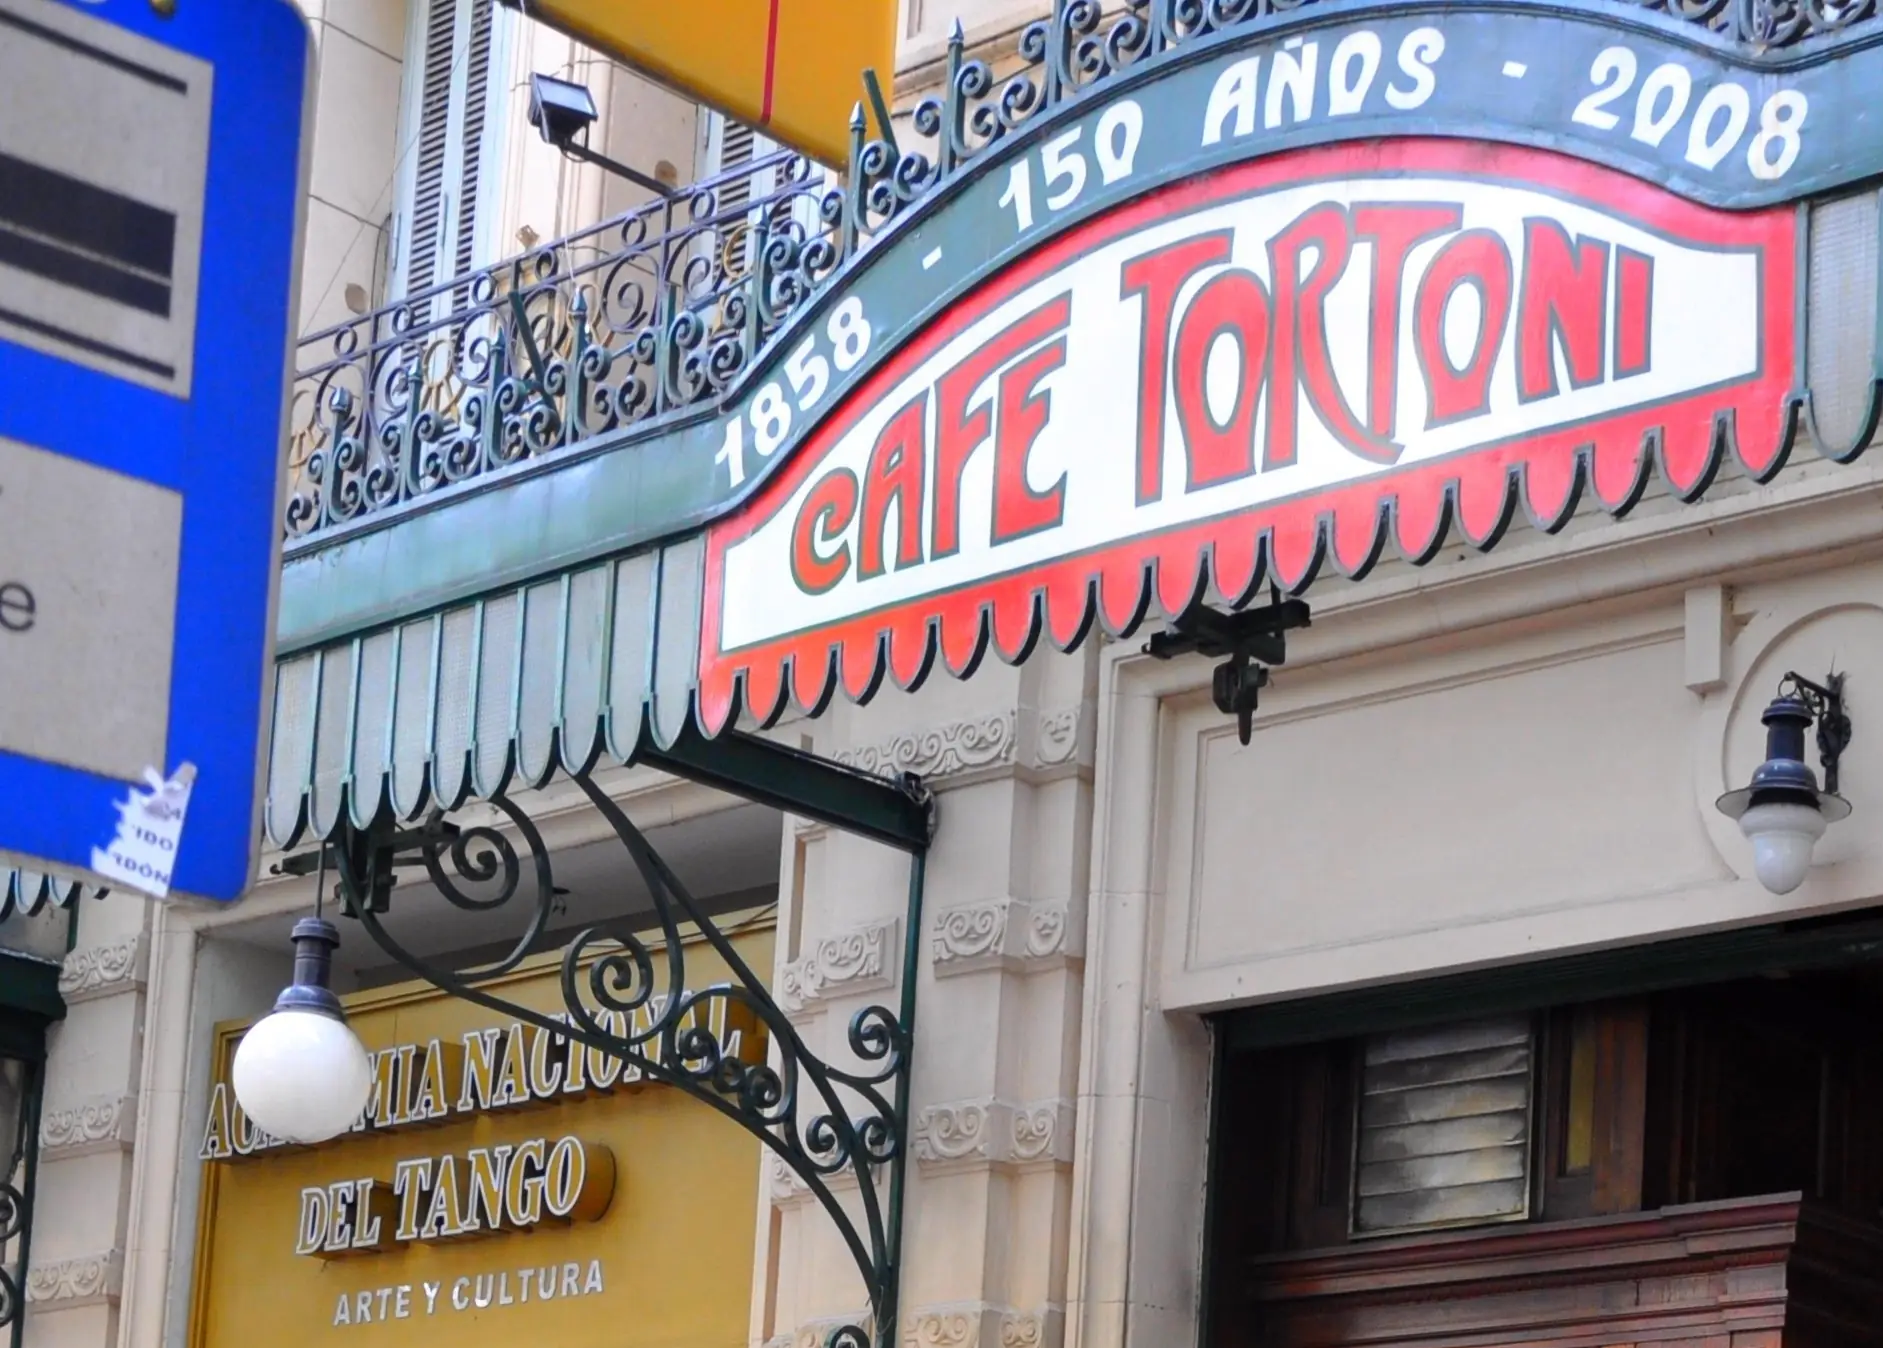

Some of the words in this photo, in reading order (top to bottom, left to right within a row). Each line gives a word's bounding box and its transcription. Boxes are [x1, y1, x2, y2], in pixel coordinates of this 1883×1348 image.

[714, 298, 873, 487] 1858
[999, 100, 1144, 232] 150
[1201, 26, 1447, 145] AÑOS
[1573, 49, 1808, 180] 2008
[791, 292, 1072, 597] CAFE
[1121, 201, 1655, 506] TORTONI
[296, 1177, 379, 1255] DEL
[395, 1135, 585, 1241] TANGO
[334, 1284, 412, 1326] ARTE
[422, 1281, 440, 1315] Y
[453, 1259, 604, 1311] CULTURA
